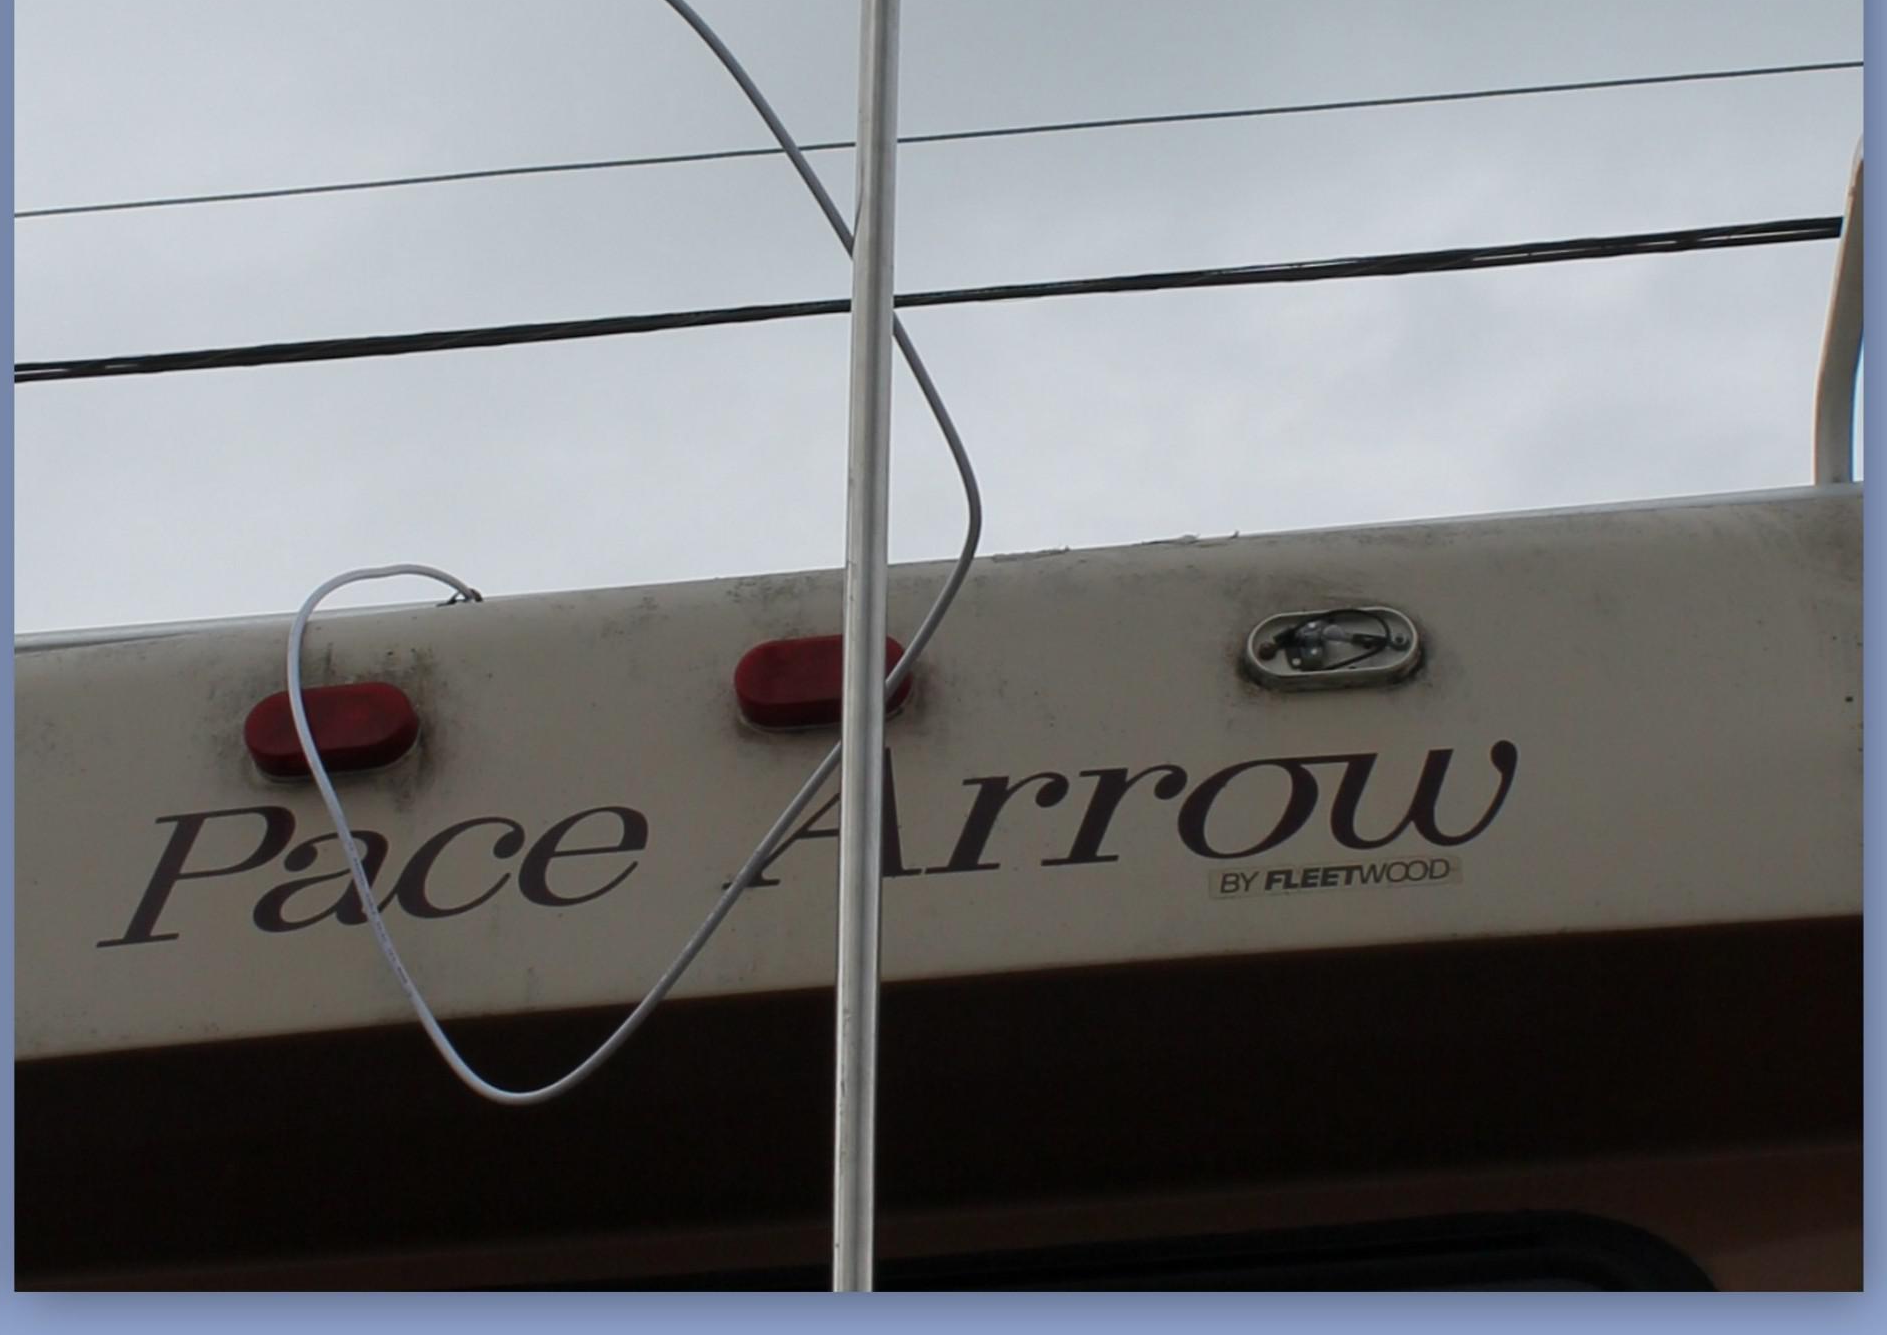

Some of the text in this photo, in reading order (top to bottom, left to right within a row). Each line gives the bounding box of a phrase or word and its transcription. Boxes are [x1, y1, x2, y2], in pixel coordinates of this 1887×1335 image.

[96, 805, 649, 948] Pace
[722, 739, 1518, 890] Arrow
[1220, 857, 1451, 894] BY FLEETWOOD
